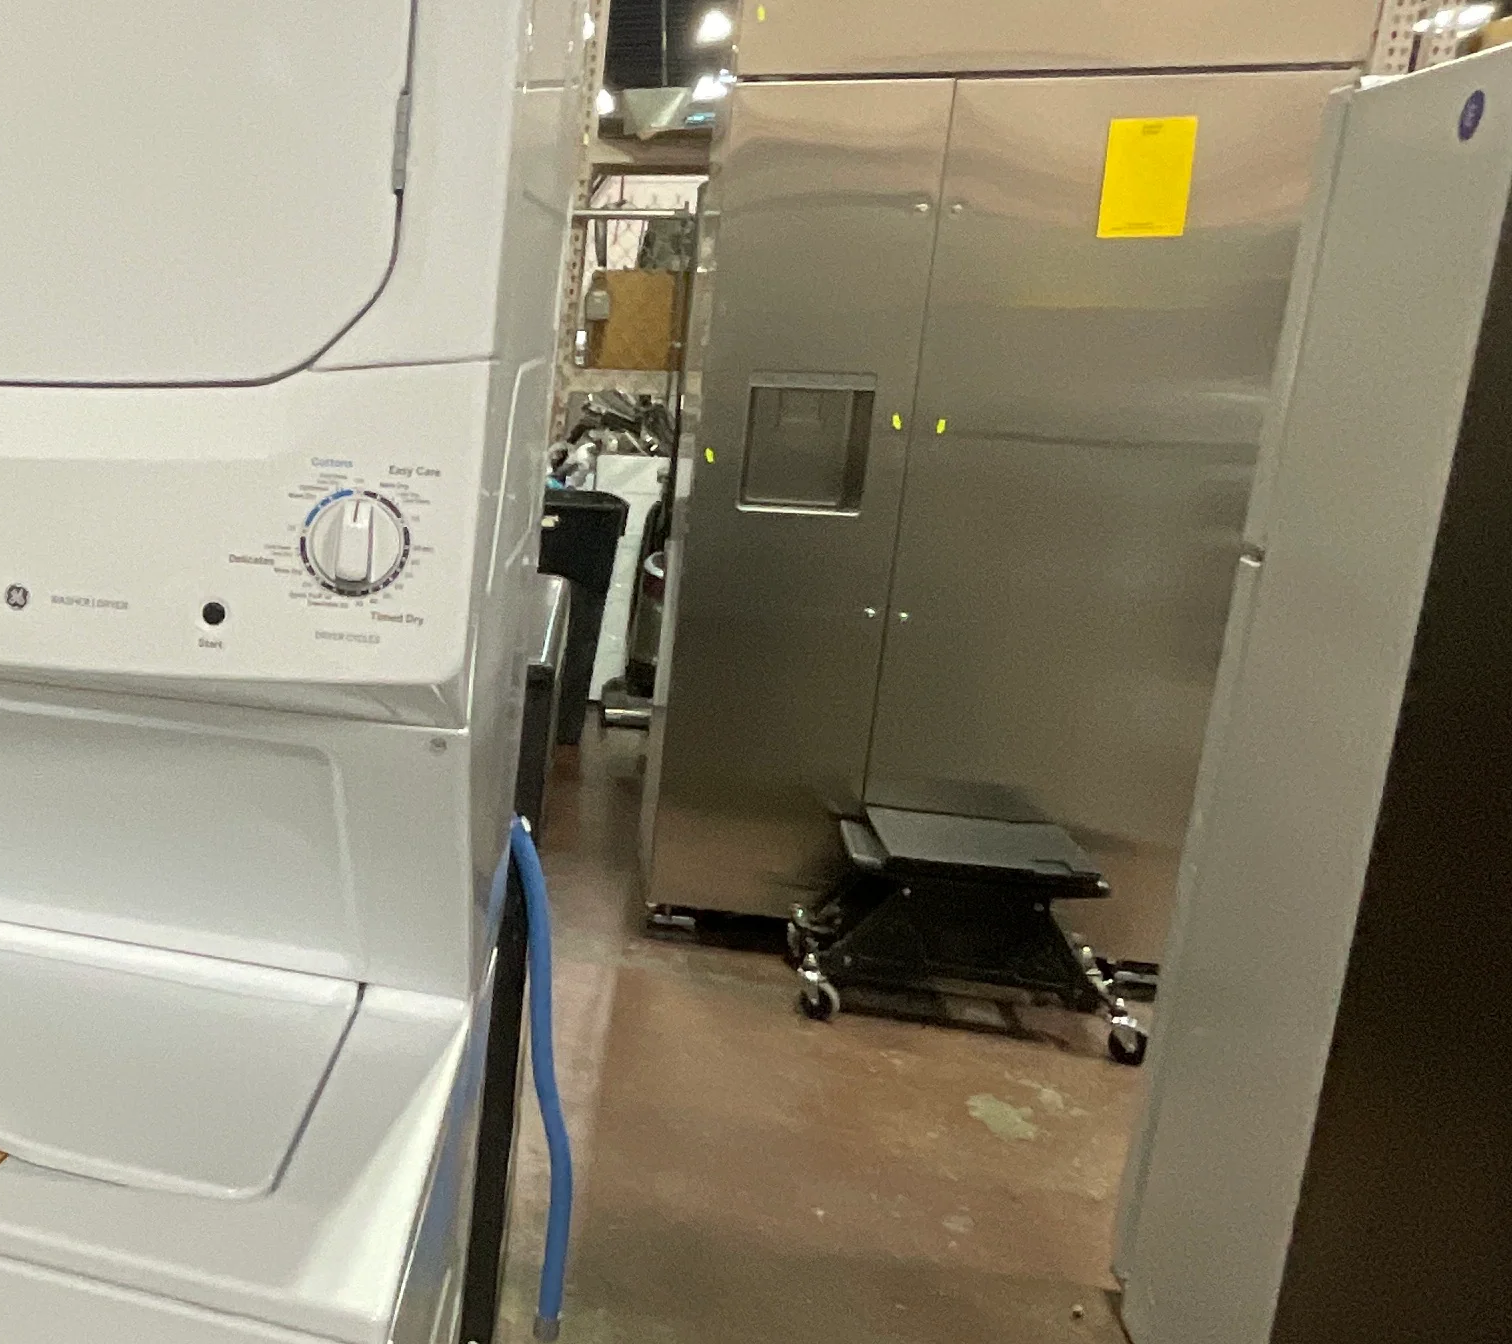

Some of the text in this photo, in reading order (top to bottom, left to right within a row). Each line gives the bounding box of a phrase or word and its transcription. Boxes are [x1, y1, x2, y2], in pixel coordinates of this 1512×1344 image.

[389, 465, 441, 477] Easy Care
[371, 611, 424, 626] Timed Dry
[198, 638, 223, 650] Start
